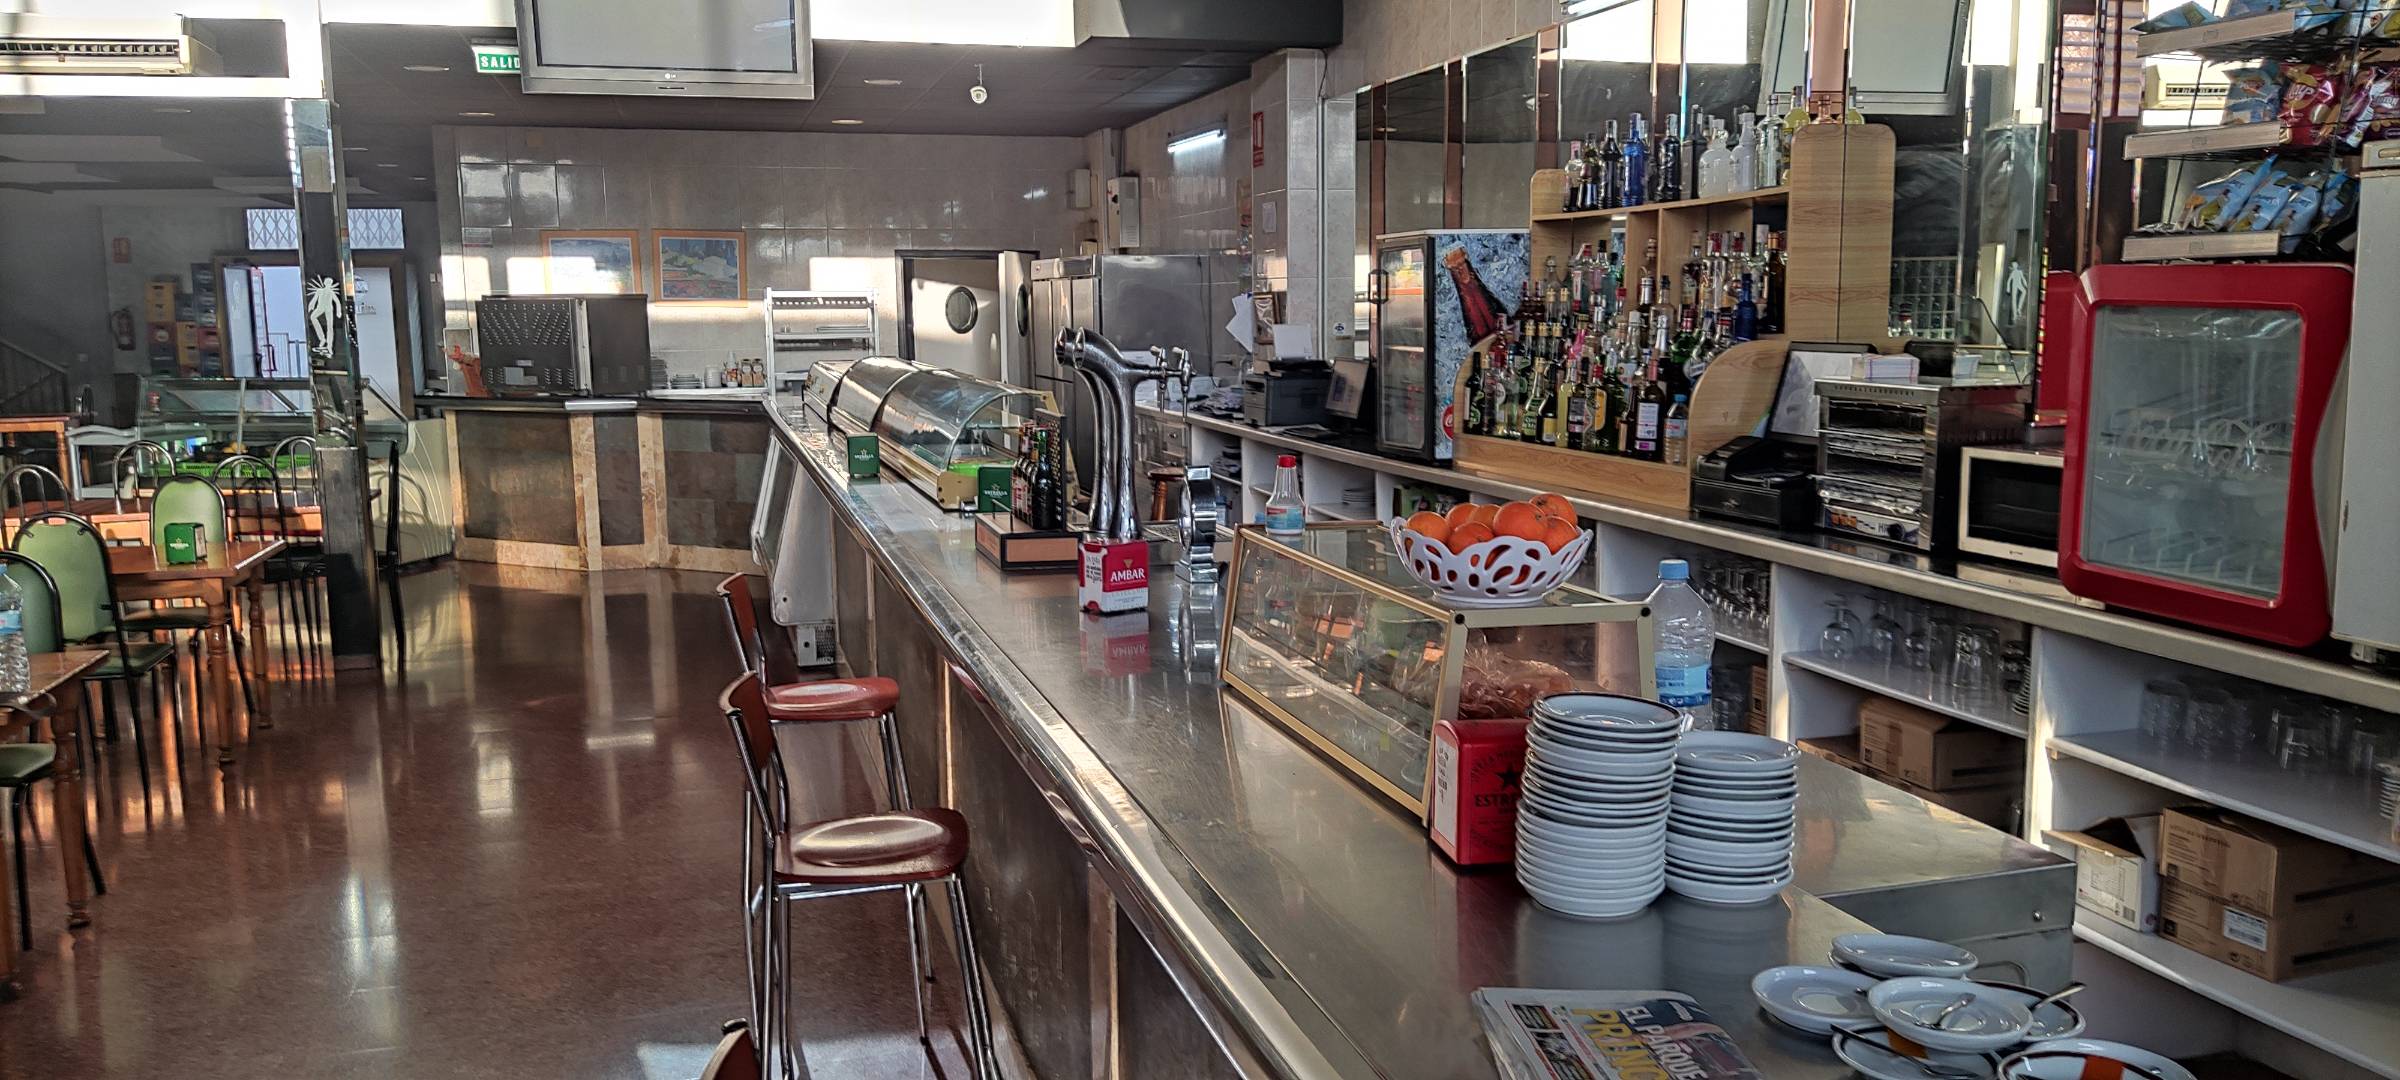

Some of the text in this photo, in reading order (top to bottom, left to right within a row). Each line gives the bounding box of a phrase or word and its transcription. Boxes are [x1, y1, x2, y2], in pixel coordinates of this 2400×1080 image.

[481, 56, 520, 68] SALID
[1110, 567, 1145, 582] AMBAR
[1475, 793, 1521, 807] ESTRE
[1620, 1005, 1654, 1025] EL
[1633, 1024, 1709, 1080] PARQUE
